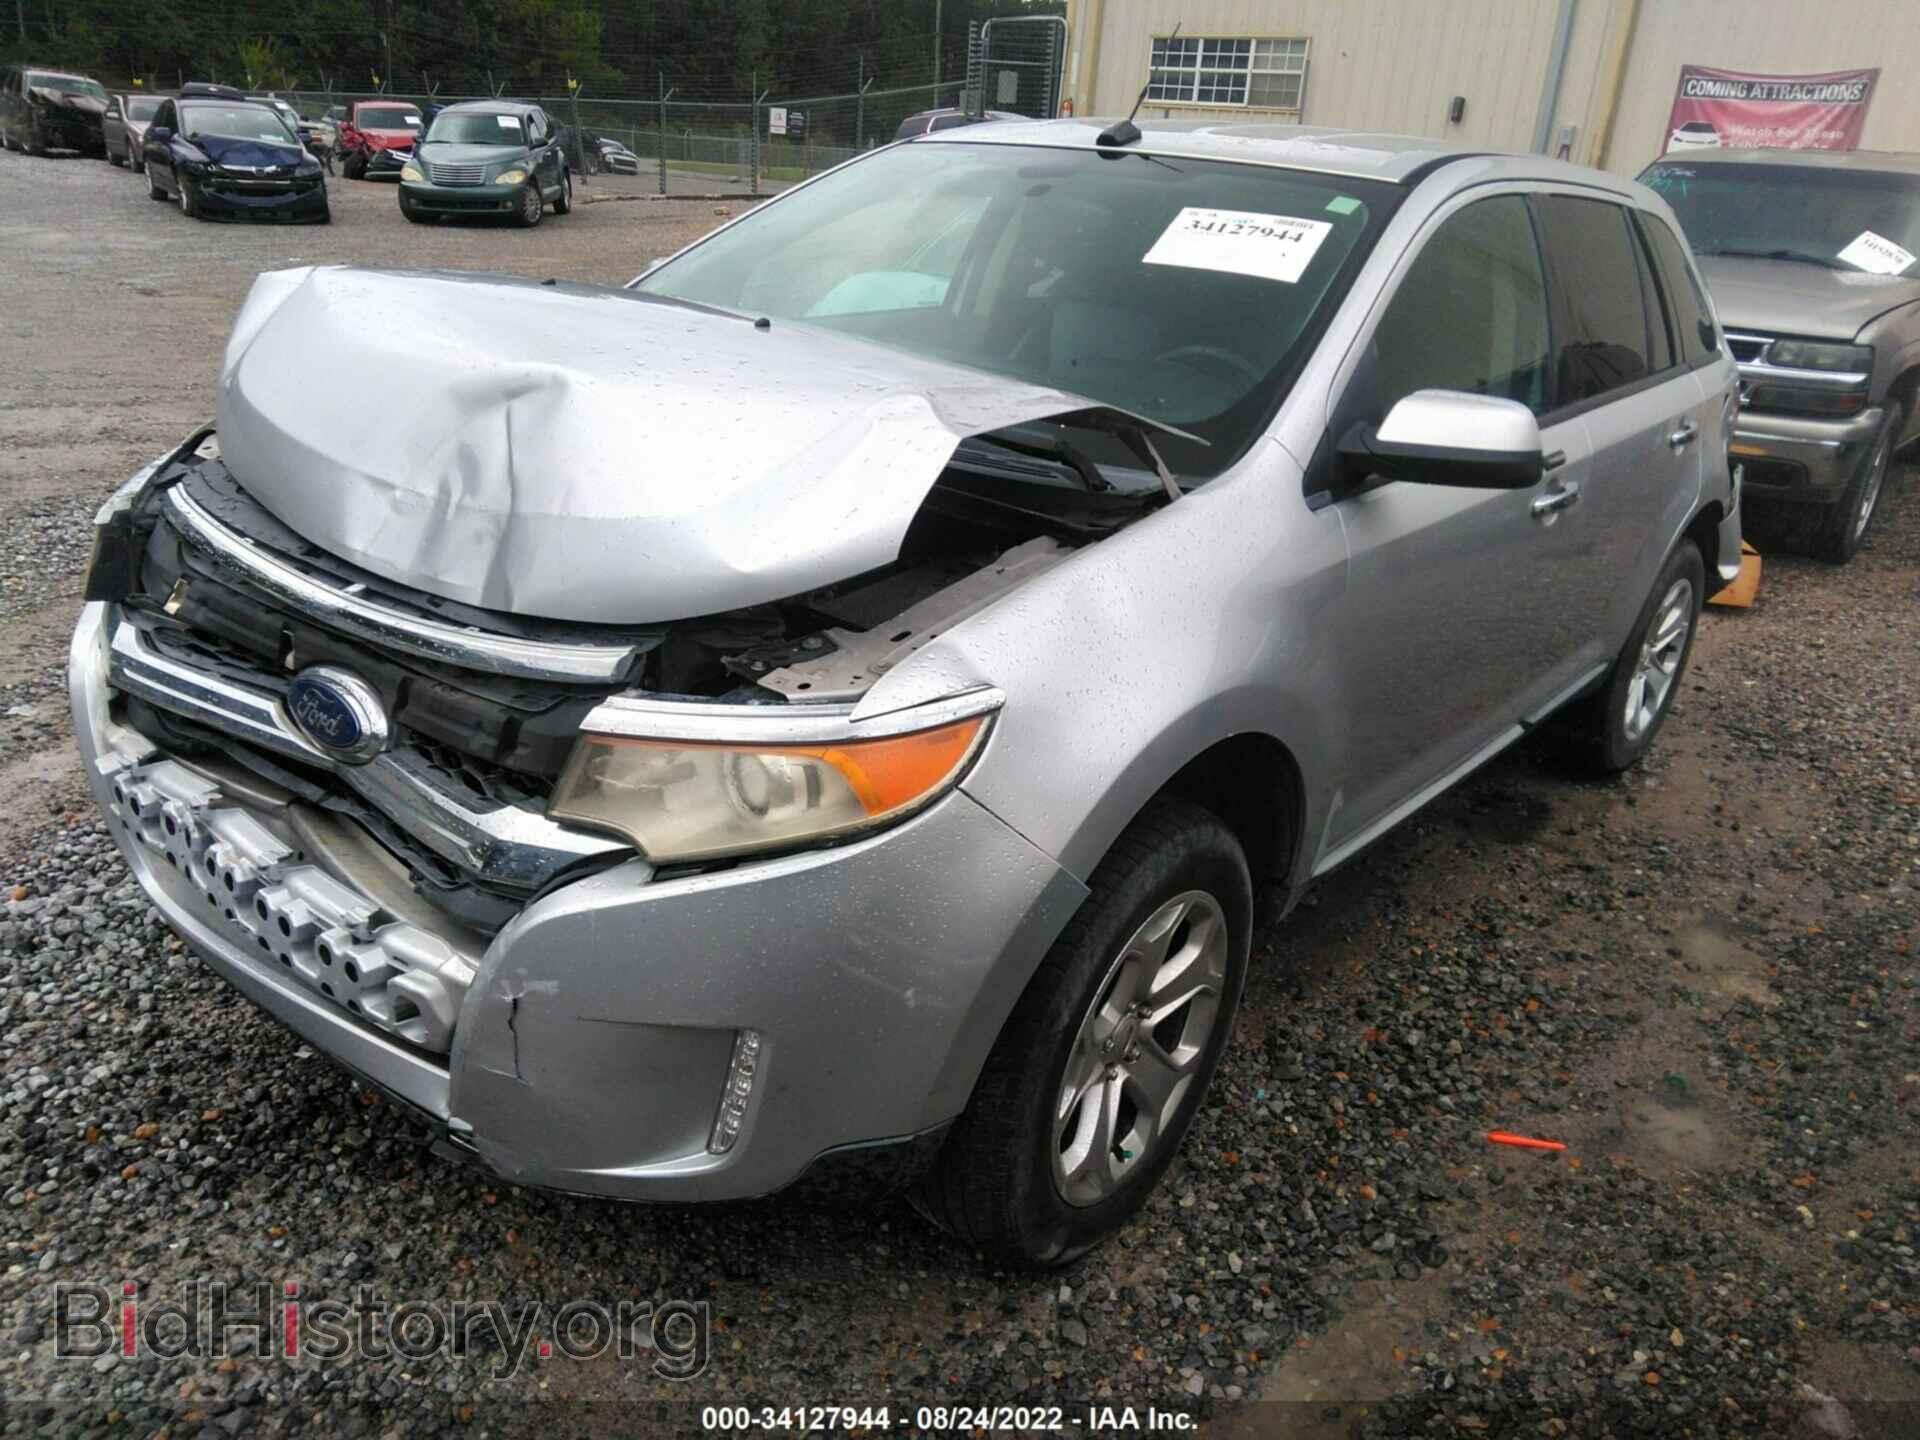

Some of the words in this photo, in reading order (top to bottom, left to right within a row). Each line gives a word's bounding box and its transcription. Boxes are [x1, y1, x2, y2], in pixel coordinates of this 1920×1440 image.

[1687, 79, 1747, 97] COMING
[1750, 82, 1863, 101] ATTRACTIONS
[1184, 219, 1304, 243] 34127944
[297, 687, 343, 737] Ford
